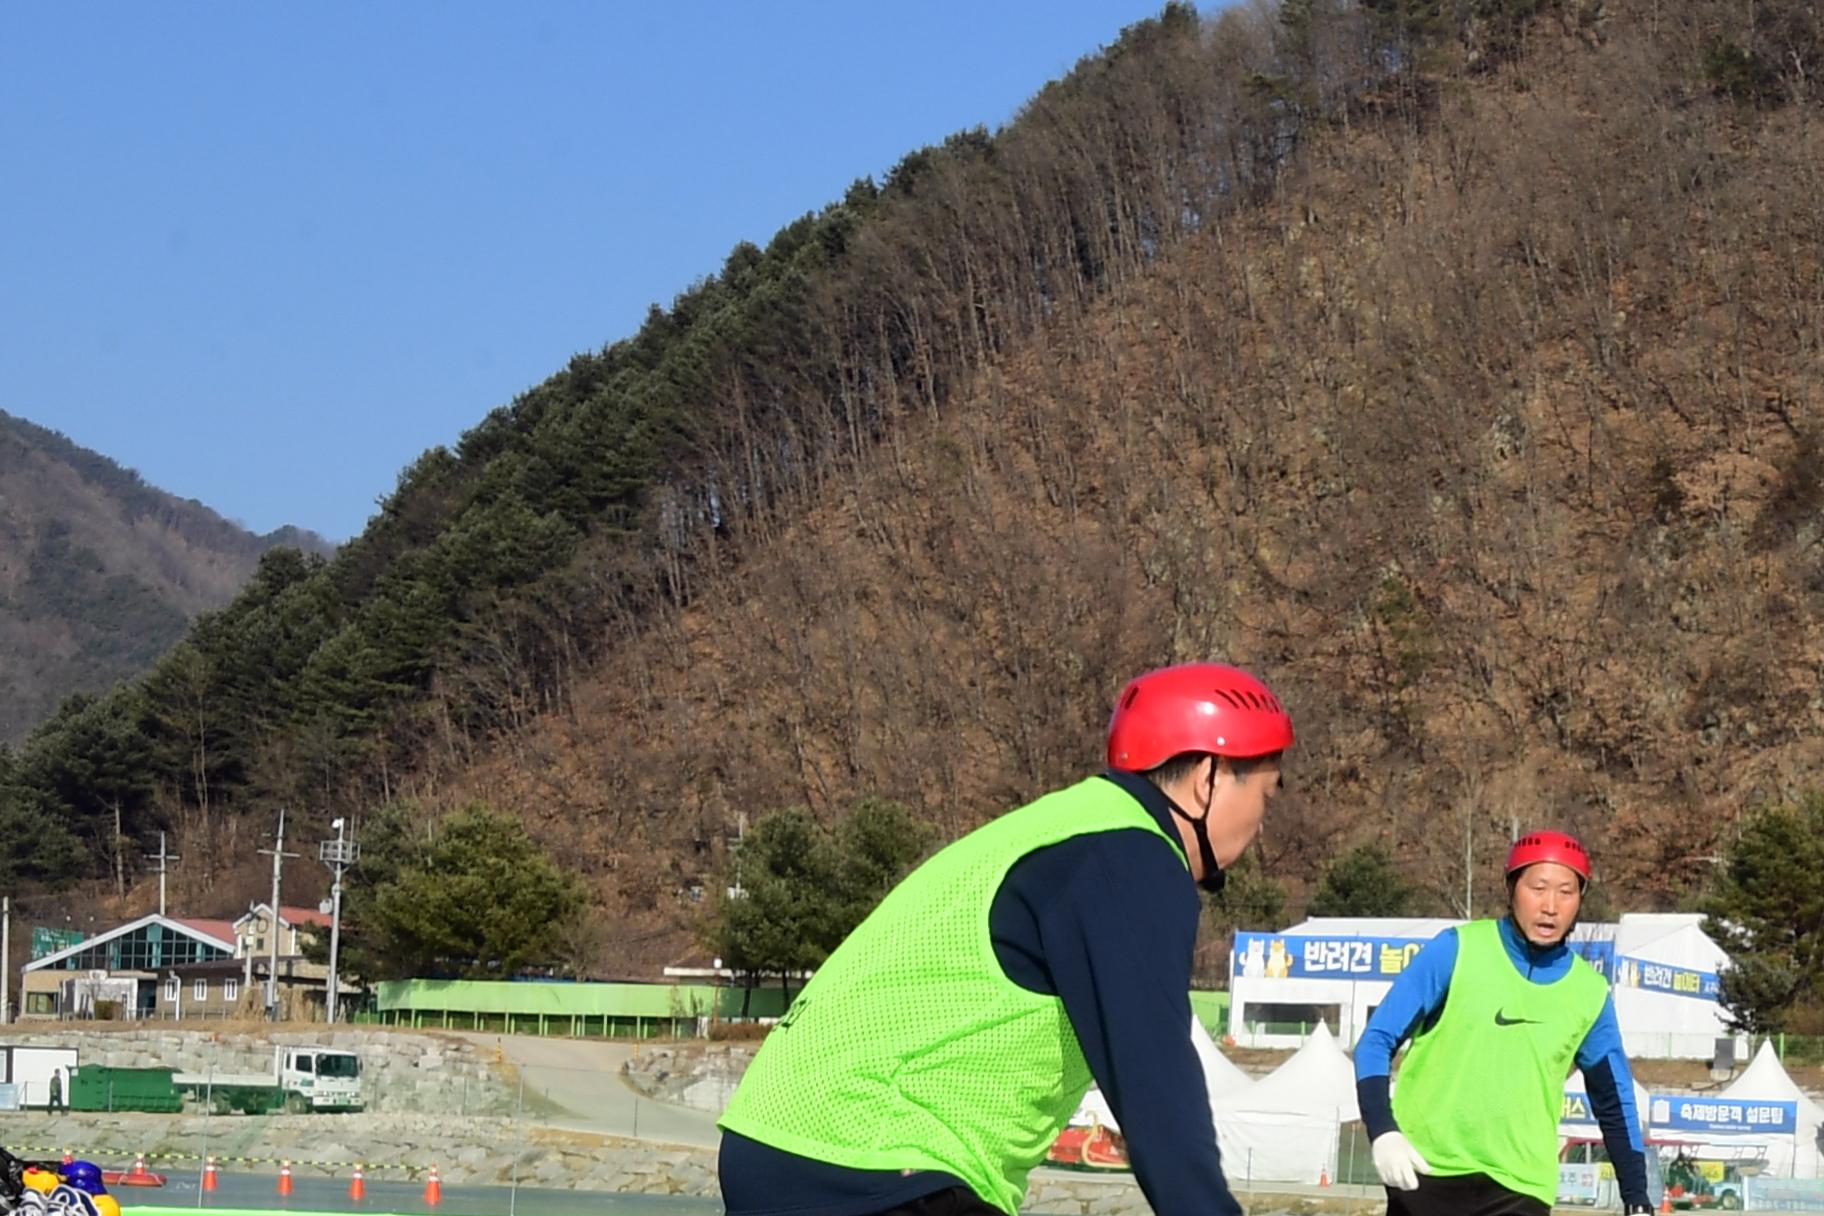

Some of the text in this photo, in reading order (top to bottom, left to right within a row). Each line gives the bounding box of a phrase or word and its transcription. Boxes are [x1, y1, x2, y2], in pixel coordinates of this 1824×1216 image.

[1304, 941, 1373, 973] 반려견
[1644, 965, 1673, 989] 반려견
[1680, 1104, 1742, 1123] 축제방문객
